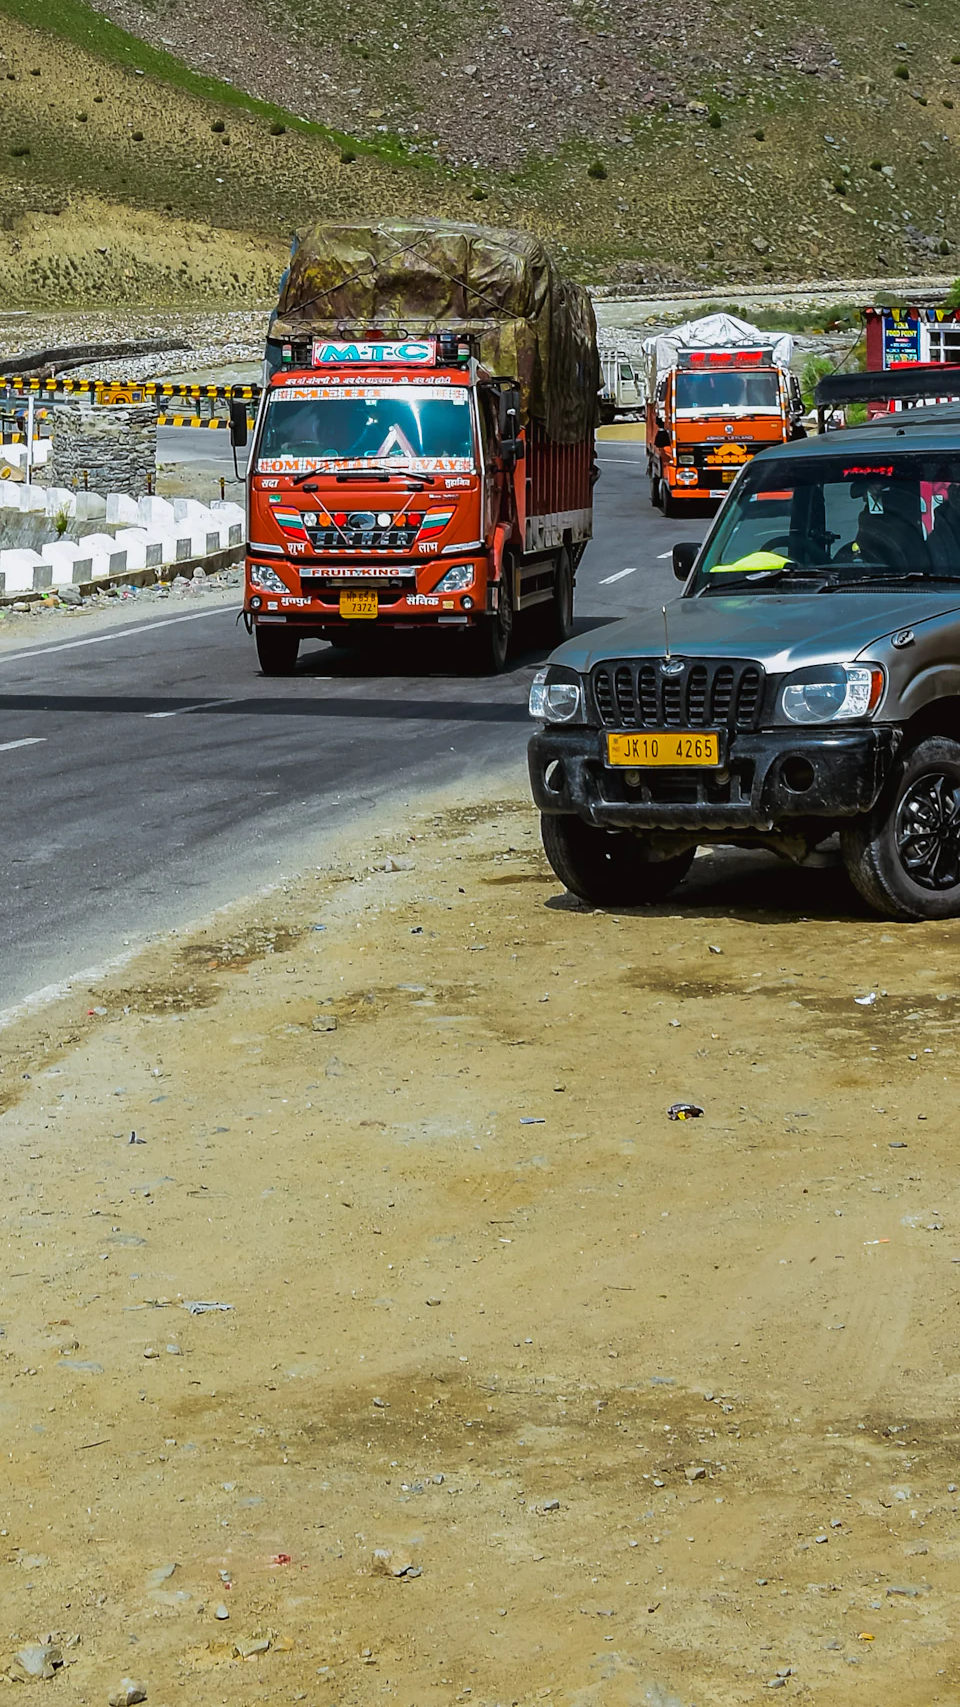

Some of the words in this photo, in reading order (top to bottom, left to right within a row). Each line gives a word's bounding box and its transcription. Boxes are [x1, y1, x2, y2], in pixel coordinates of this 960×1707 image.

[261, 478, 280, 488] सदा
[316, 531, 409, 546] EICHER
[286, 542, 306, 556] शुभ
[417, 541, 439, 553] लाभ
[346, 592, 357, 602] HP
[406, 593, 440, 606] सैनिक
[352, 603, 373, 612] 7372
[623, 739, 659, 758] JK10
[676, 739, 712, 758] 4265
